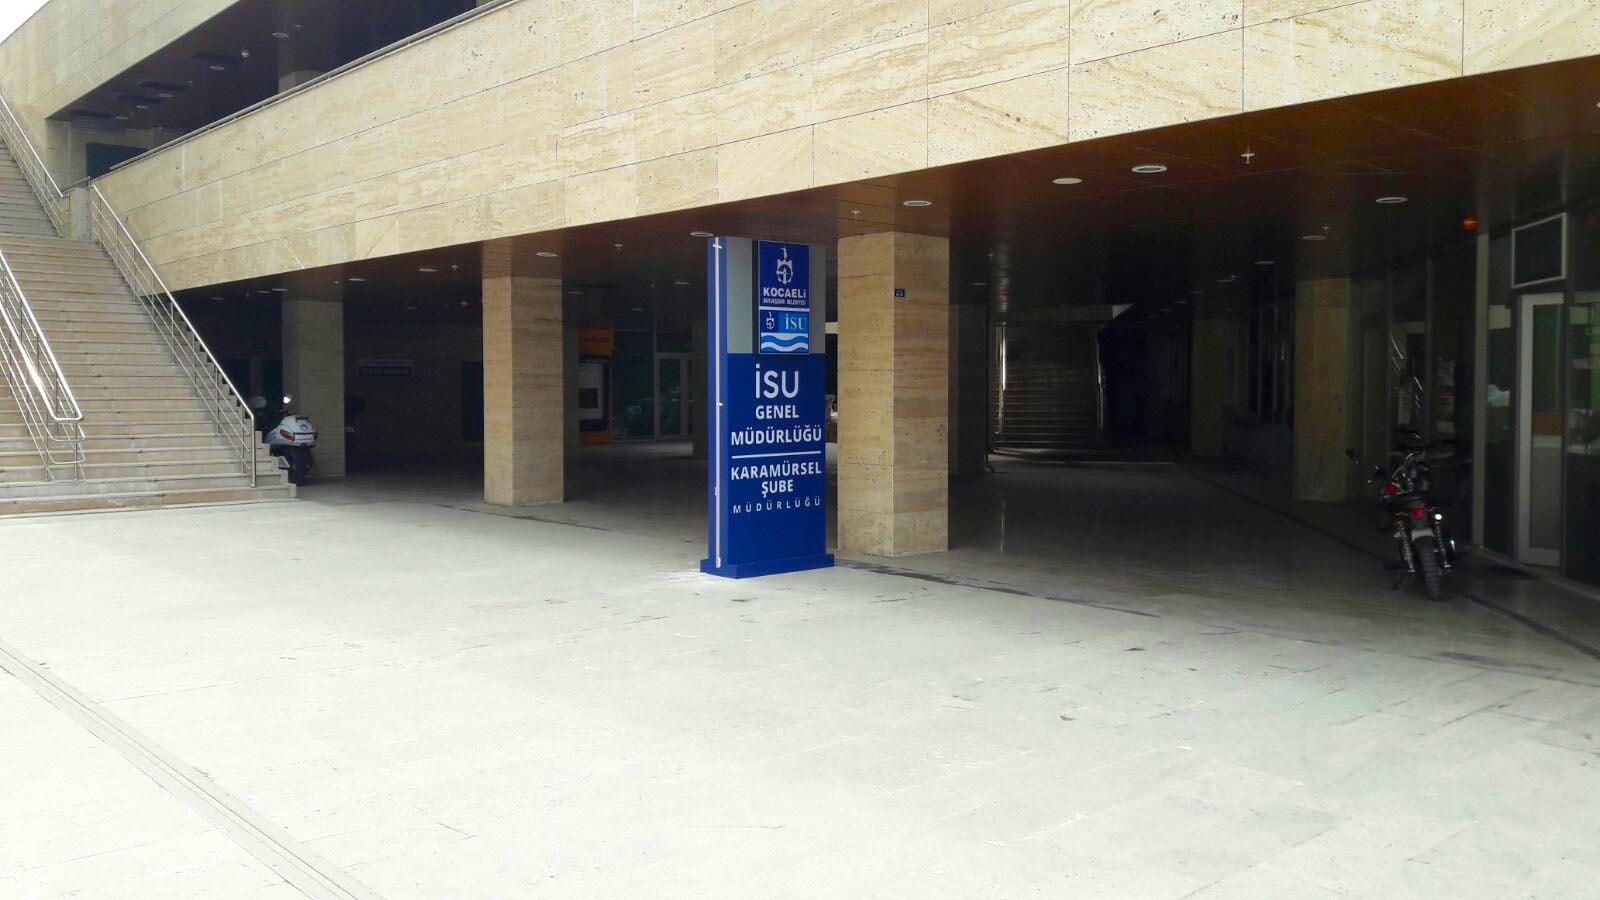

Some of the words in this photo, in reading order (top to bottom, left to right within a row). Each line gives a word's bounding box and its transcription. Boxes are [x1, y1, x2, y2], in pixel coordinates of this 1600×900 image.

[785, 313, 807, 330] İSU
[755, 363, 799, 399] İSU
[755, 404, 799, 420] GENEL
[731, 424, 822, 446] MÜDÜRLÜĞÜ
[731, 460, 822, 481] KARAMÜRSEL
[761, 479, 794, 498] ŞUBE
[732, 496, 821, 515] MÜDÜRLÜĞÜ
